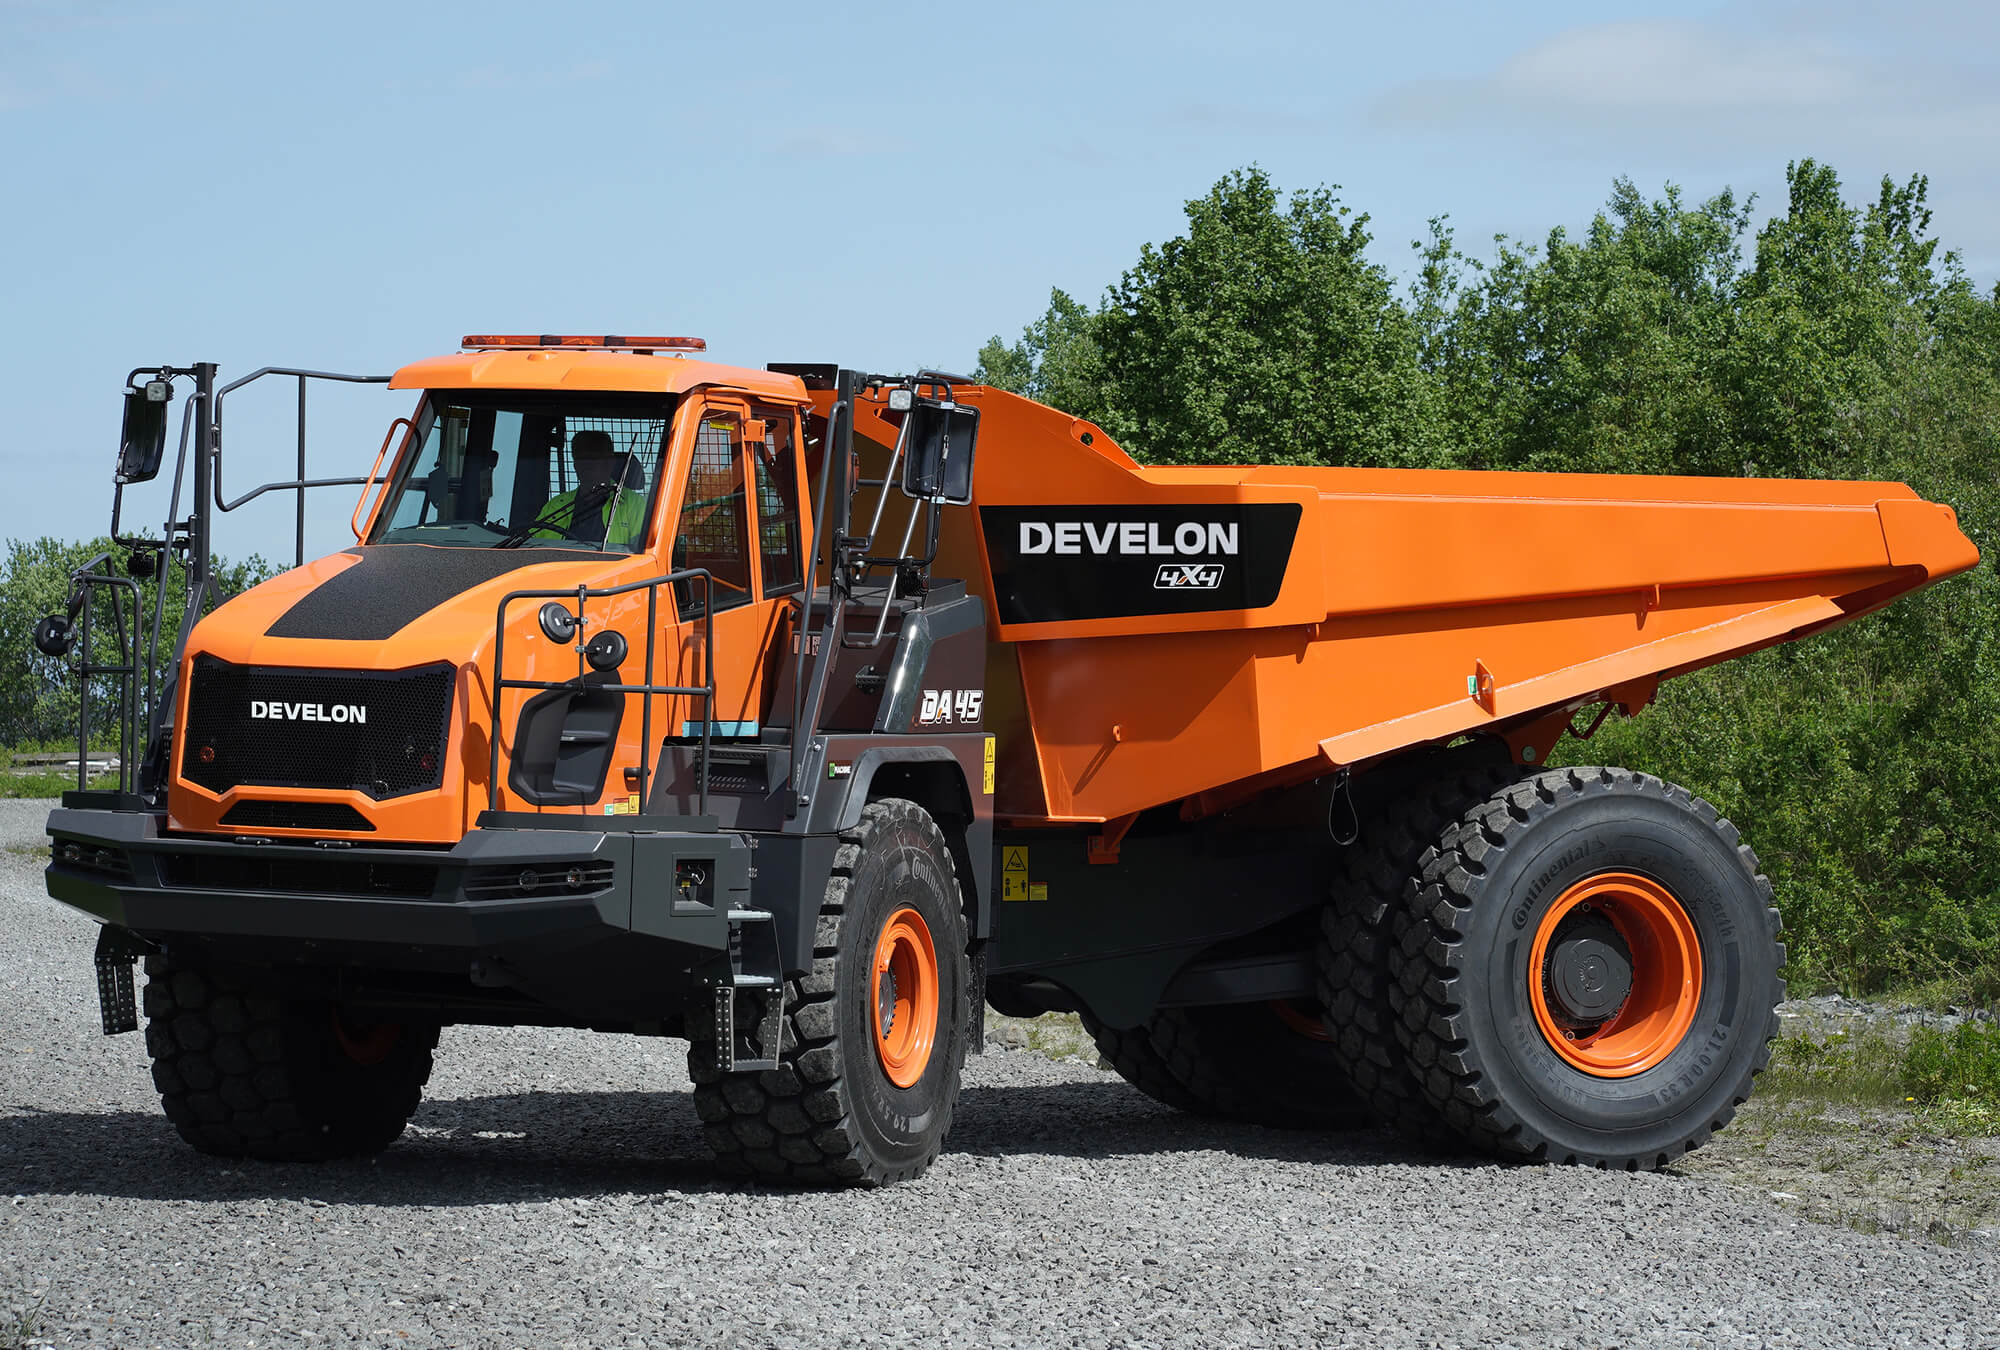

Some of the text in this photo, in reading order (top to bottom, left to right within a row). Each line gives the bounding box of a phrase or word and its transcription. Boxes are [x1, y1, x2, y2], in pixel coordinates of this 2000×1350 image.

[1019, 522, 1239, 555] DEVELON
[1160, 564, 1219, 587] 4X4
[251, 701, 366, 724] DEVELON
[920, 689, 984, 724] DA 45
[1511, 839, 1591, 930] Continental
